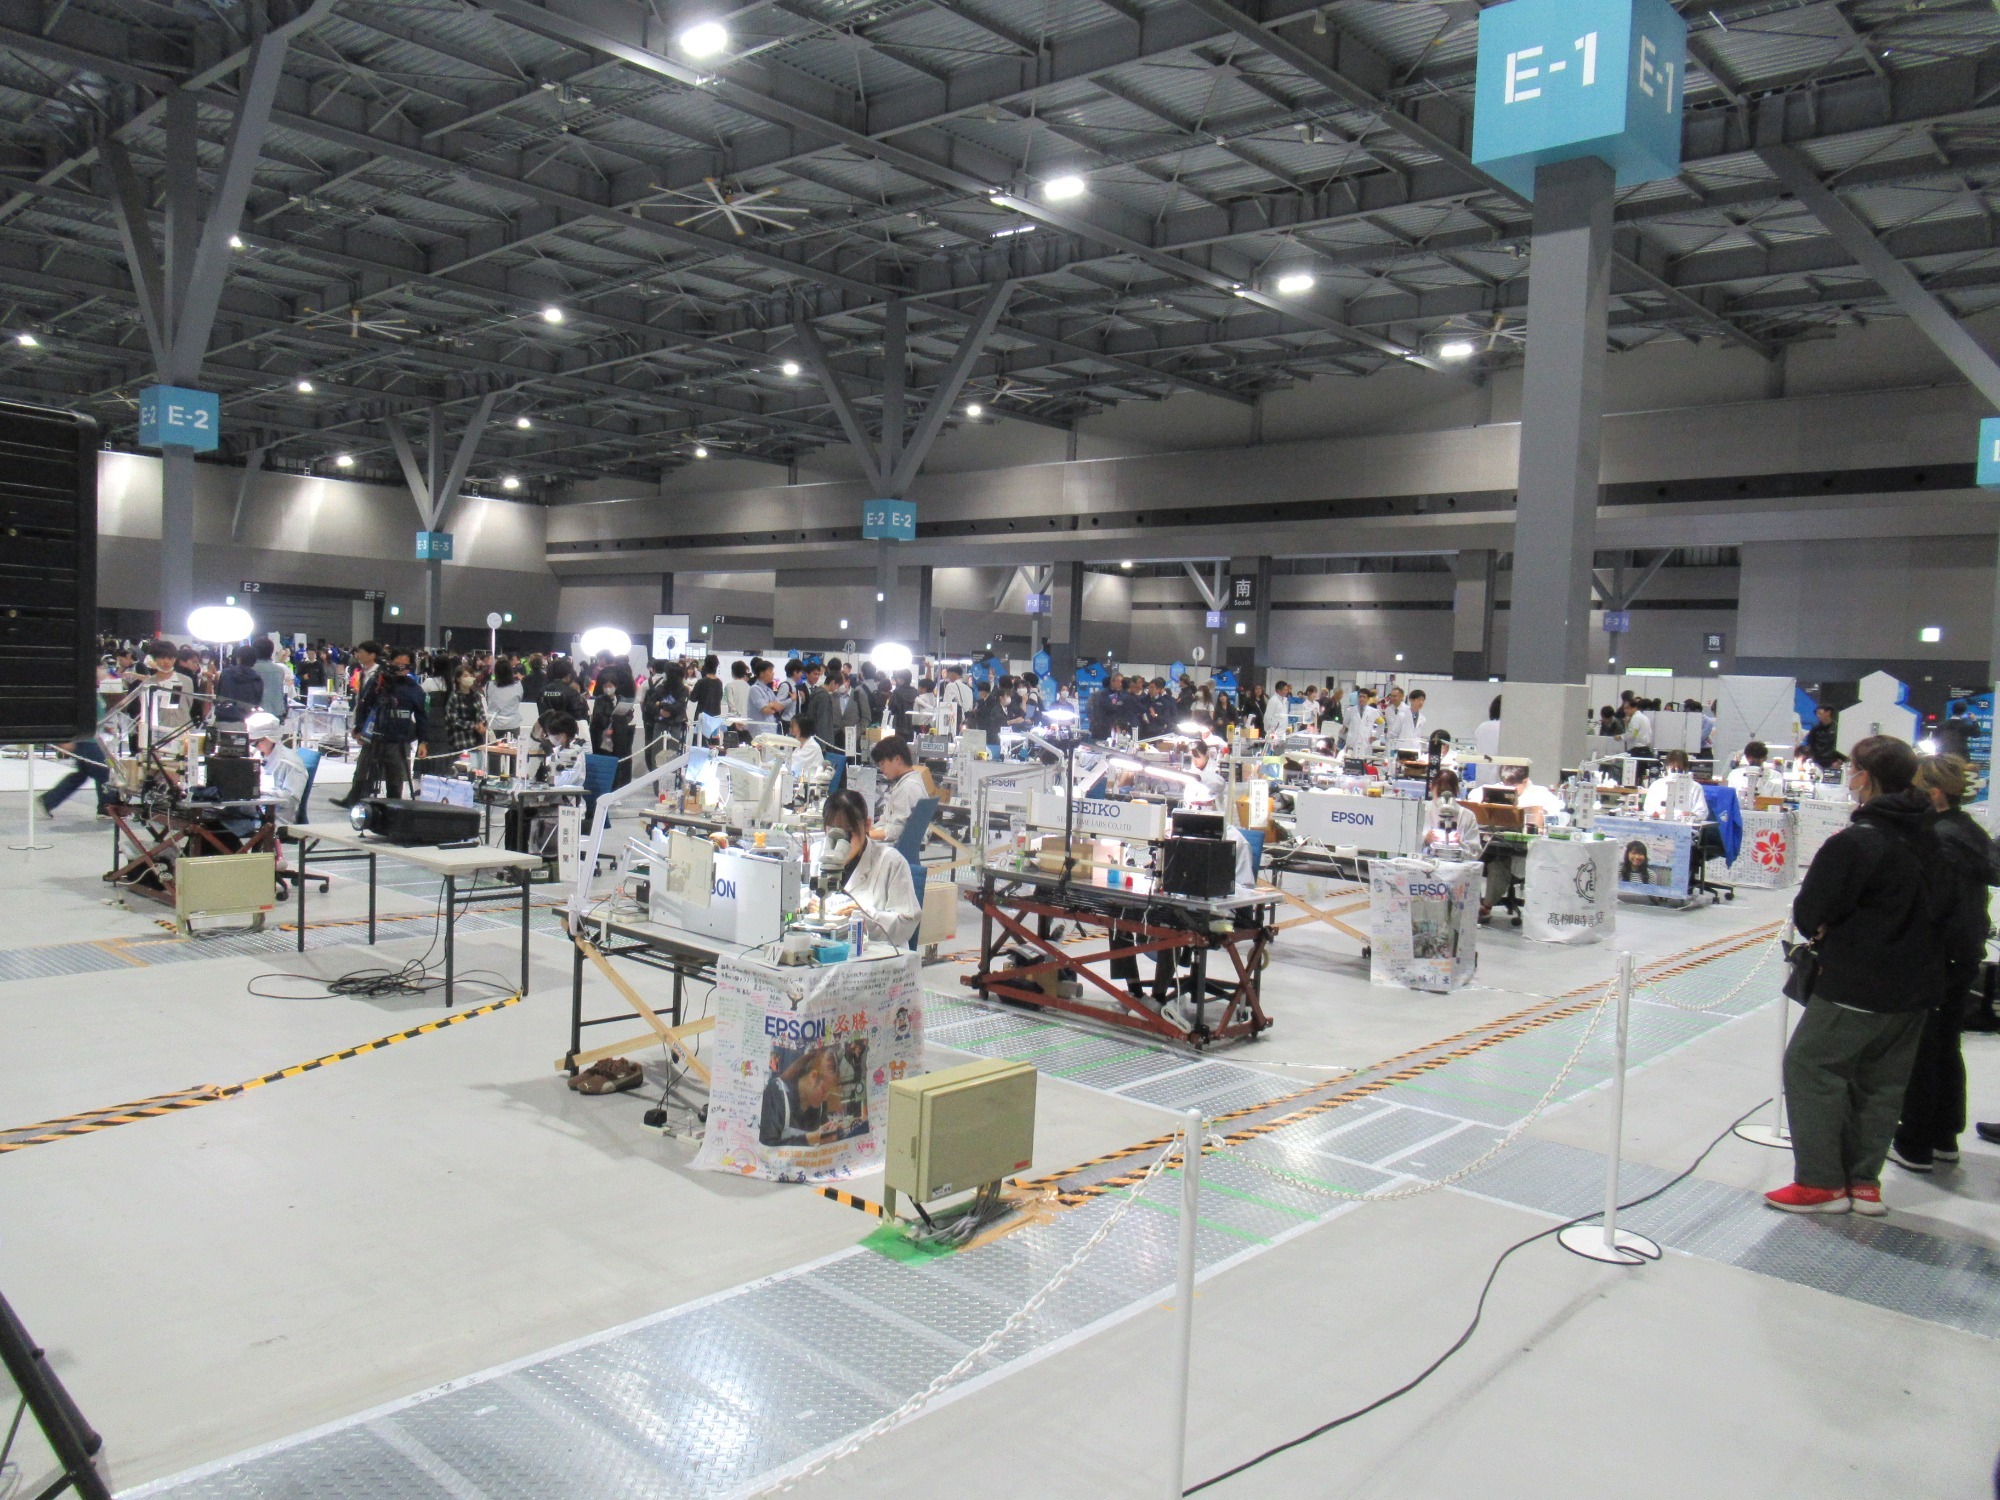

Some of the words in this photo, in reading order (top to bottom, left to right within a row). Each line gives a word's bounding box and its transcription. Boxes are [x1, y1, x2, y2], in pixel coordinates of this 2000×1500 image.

[1504, 31, 1598, 105] E-1
[1638, 34, 1675, 115] E-1
[141, 405, 156, 426] E-2
[168, 404, 209, 430] E-2
[866, 512, 885, 526] E-2
[892, 512, 912, 528] E-2
[432, 540, 449, 551] E-3
[243, 582, 260, 593] E2
[1235, 579, 1251, 598] 南
[922, 742, 944, 752] SEIKO
[1071, 800, 1121, 818] SEIKO
[1804, 803, 1833, 811] CITIZEN
[1331, 811, 1374, 826] EPSON
[764, 1015, 826, 1041] EPSON
[834, 1009, 868, 1033] 必勝
